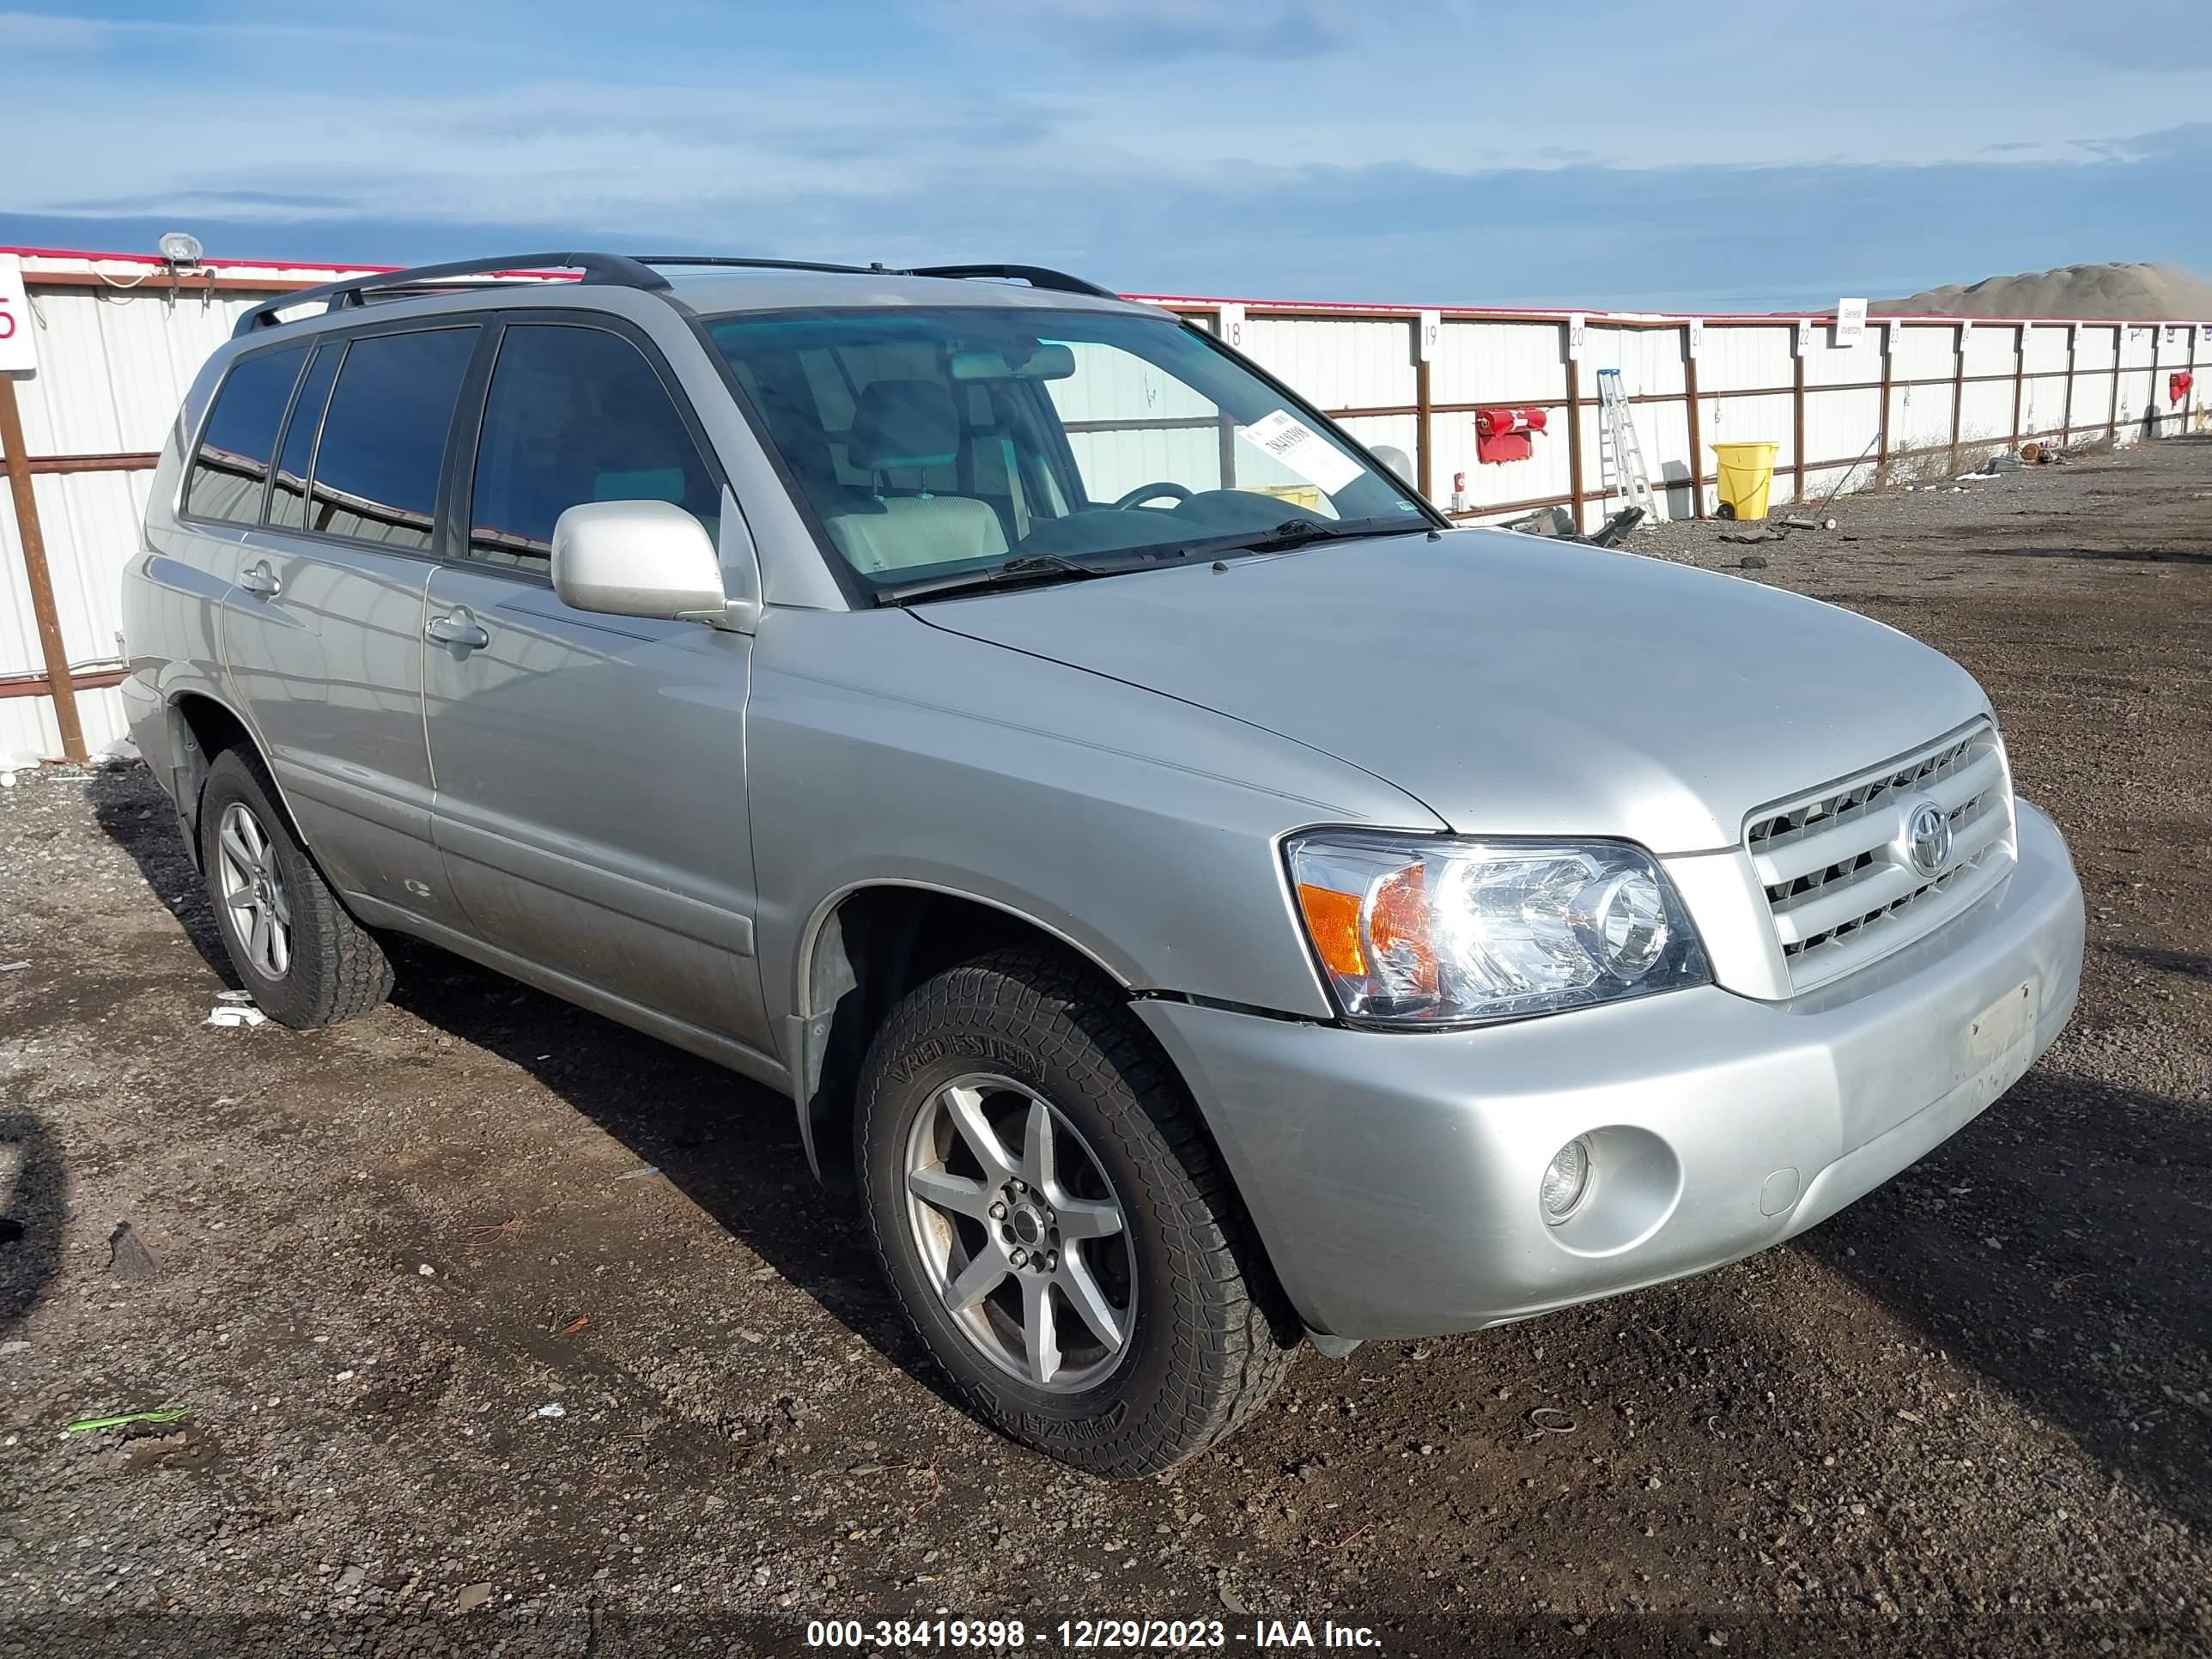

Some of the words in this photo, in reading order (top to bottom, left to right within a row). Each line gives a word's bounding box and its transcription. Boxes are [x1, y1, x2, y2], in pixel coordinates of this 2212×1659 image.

[1844, 308, 1863, 319] General
[1225, 322, 1241, 346] 18
[1425, 325, 1437, 346] 19
[1571, 326, 1583, 347] 20
[1692, 328, 1702, 347] 21
[1799, 328, 1810, 346] 22
[1890, 327, 1899, 343] 23
[890, 1031, 1047, 1085] VREDESTEIN
